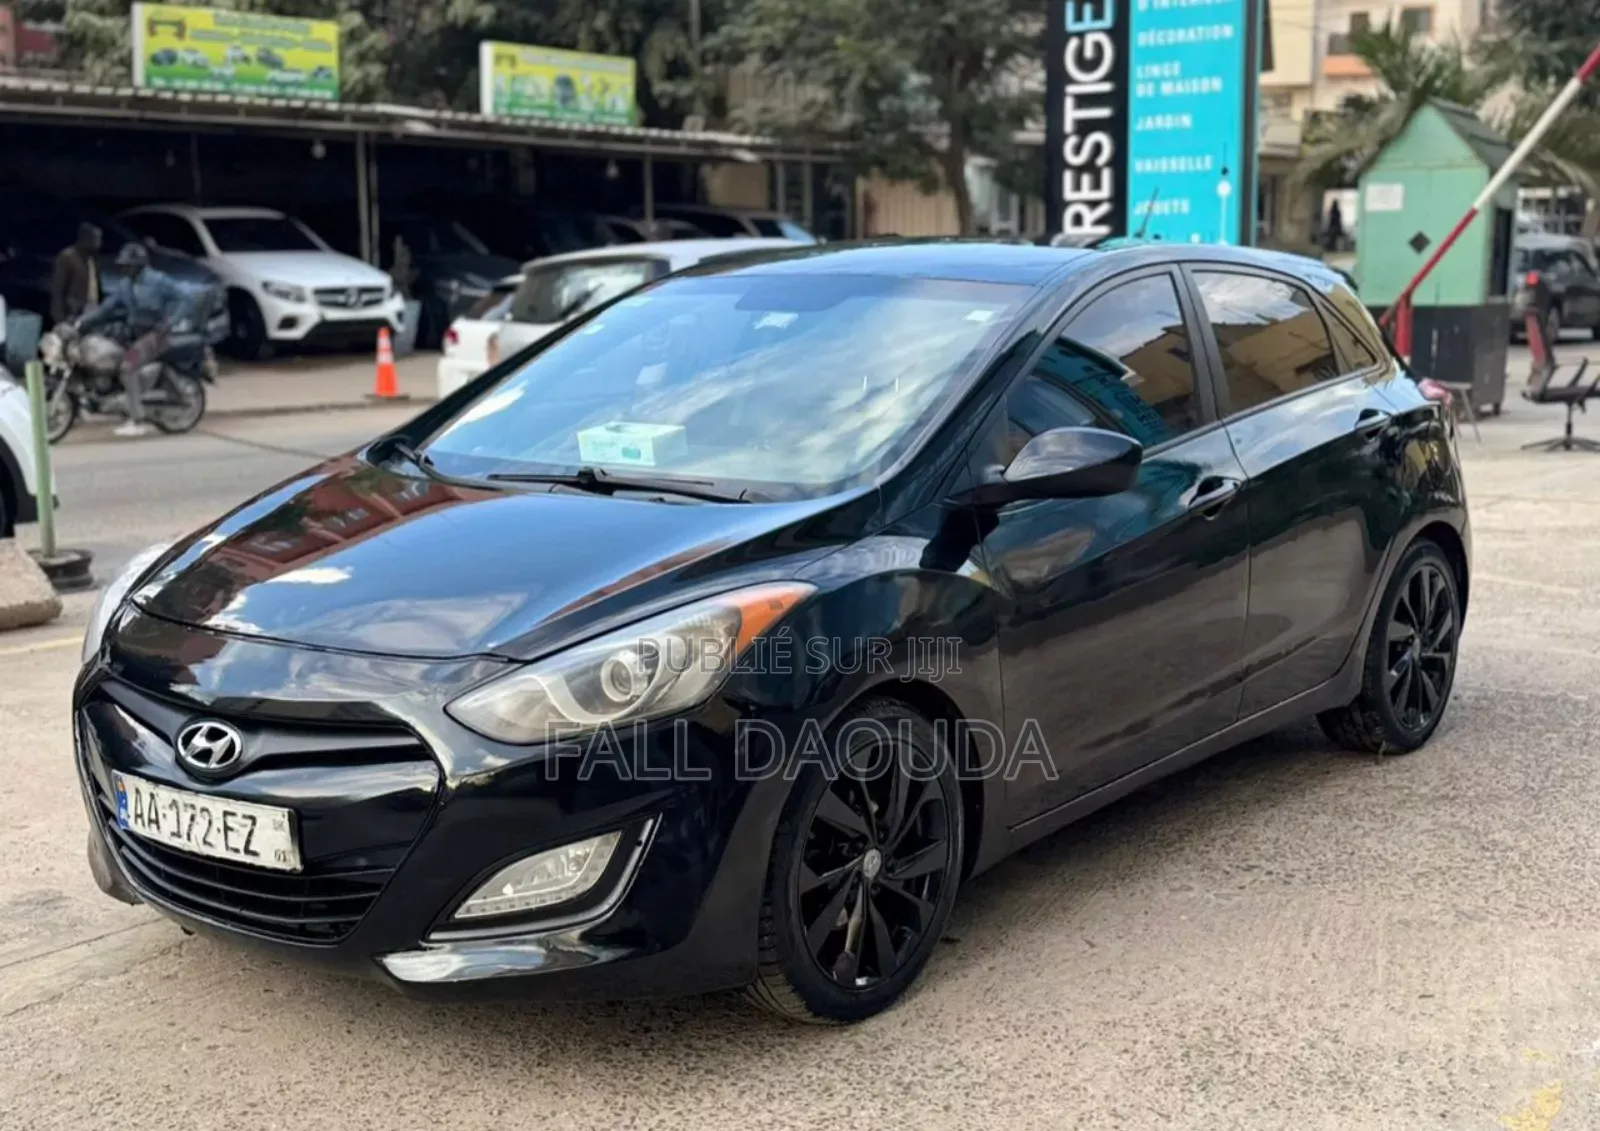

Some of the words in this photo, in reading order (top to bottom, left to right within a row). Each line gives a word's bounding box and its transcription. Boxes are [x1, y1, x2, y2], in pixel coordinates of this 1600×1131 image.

[1136, 82, 1154, 97] DE
[1160, 76, 1223, 95] MAISON
[1136, 113, 1192, 131] JARDIN
[134, 787, 260, 857] AA-172-EZ
